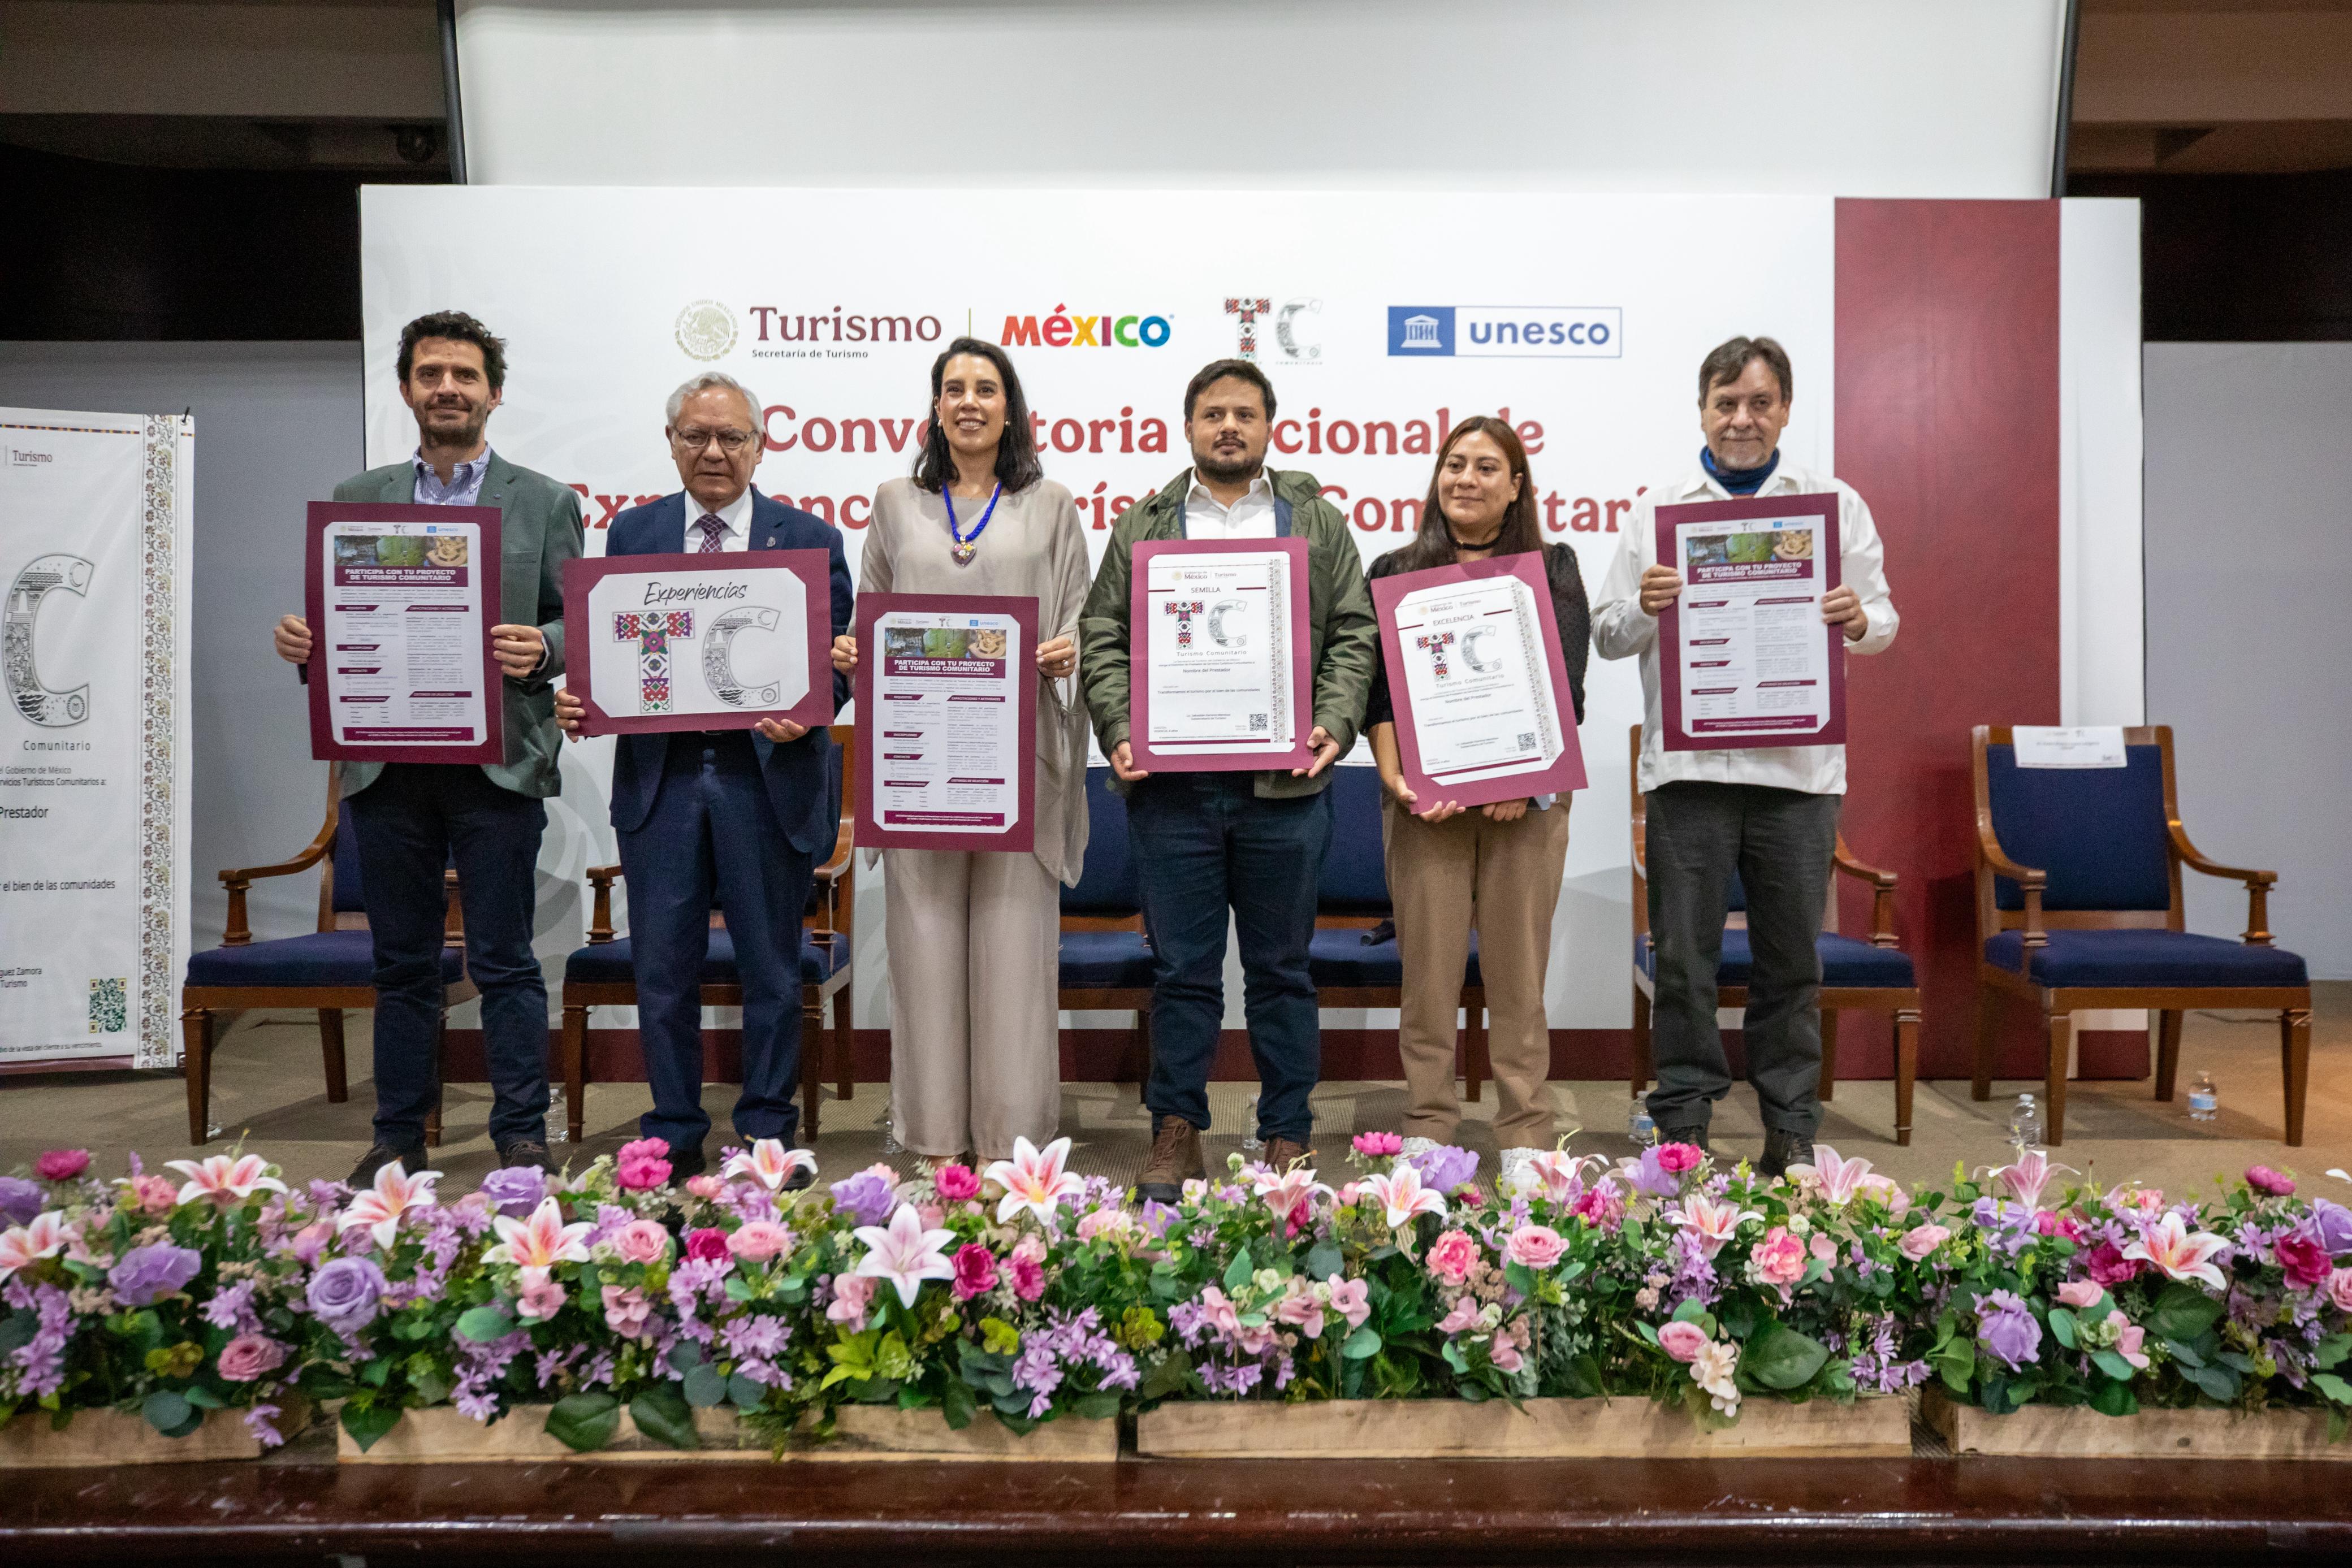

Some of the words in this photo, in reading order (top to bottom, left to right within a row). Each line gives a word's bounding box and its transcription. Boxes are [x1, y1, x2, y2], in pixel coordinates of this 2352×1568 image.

[750, 306, 941, 341] Turismo
[1470, 322, 1610, 345] unesco
[752, 349, 806, 358] Secretaría
[810, 349, 822, 358] de
[825, 350, 868, 358] Turismo
[12, 450, 53, 462] Turismo
[644, 582, 747, 605] Experiencias
[1433, 615, 1475, 626] EXCELENCIA
[1465, 674, 1504, 684] Comunitario
[23, 740, 91, 751] Comunitario
[23, 777, 55, 786] Turísticos
[3, 881, 10, 891] el
[13, 881, 31, 891] bien
[33, 880, 44, 890] de
[46, 880, 57, 890] las
[60, 878, 116, 890] comunidades
[16, 967, 42, 976] Zamora
